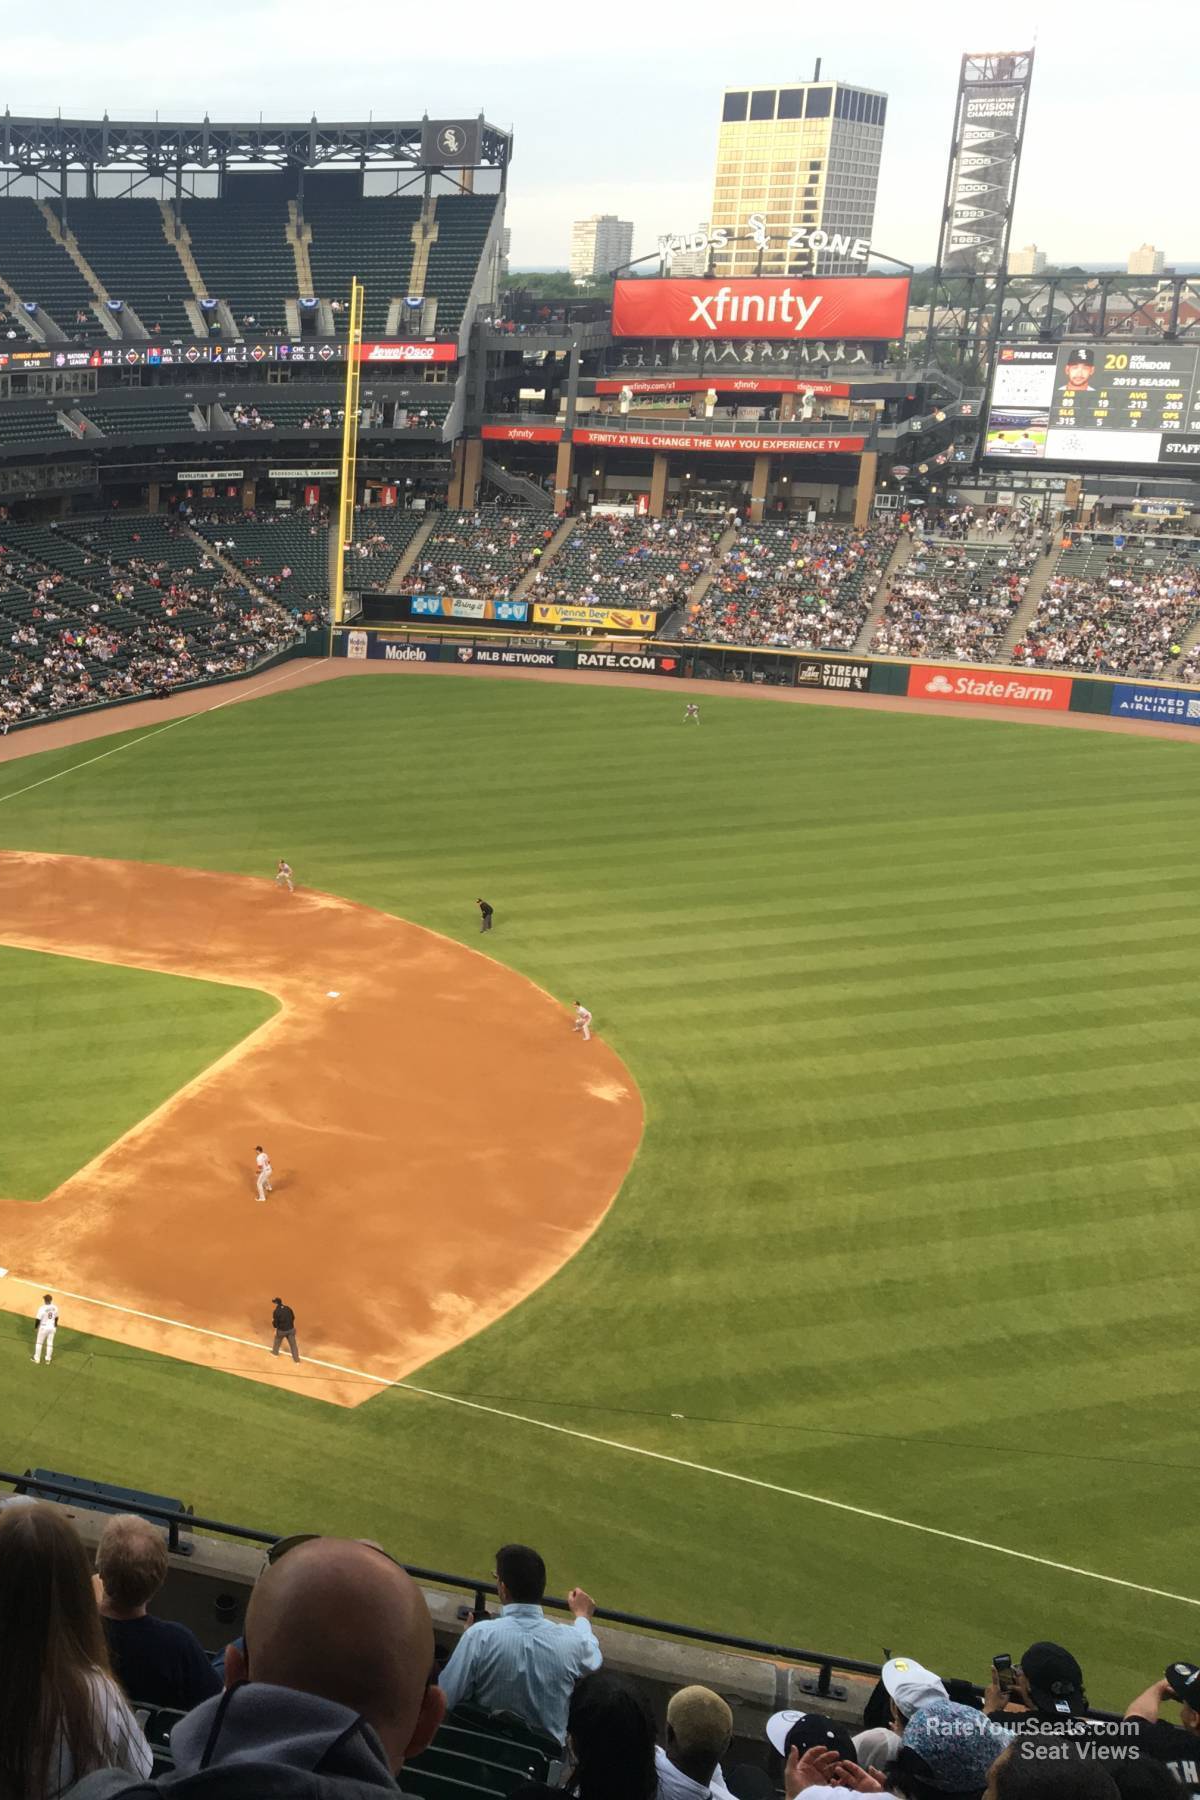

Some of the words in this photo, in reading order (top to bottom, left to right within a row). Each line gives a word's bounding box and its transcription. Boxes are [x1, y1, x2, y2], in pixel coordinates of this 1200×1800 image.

[968, 102, 1015, 111] DIVISION
[967, 110, 1014, 118] CHAMPIONS
[658, 227, 728, 261] KIDS
[788, 226, 872, 261] ZONE
[689, 286, 823, 331] xfinity
[1104, 354, 1128, 370] 20
[1129, 361, 1171, 370] RONDON
[734, 380, 760, 390] xfinity
[1113, 377, 1137, 386] 2019
[1139, 378, 1180, 387] SEASON
[508, 429, 534, 439] xfinity
[588, 433, 616, 443] XFINITY
[618, 435, 628, 444] X1
[630, 436, 651, 445] WILL
[652, 437, 691, 447] CHANGE
[693, 438, 712, 448] THE
[714, 439, 737, 449] WAY
[739, 439, 760, 449] YOU
[762, 440, 825, 449] EXPERIENCE
[826, 441, 840, 449] TV
[454, 599, 476, 610] Bring
[554, 607, 586, 617] Vienna
[589, 608, 610, 618] Beef
[385, 645, 427, 661] Modelo
[477, 651, 500, 661] MLB
[502, 652, 554, 664] NETWORK
[577, 654, 656, 670] RATE.COM
[823, 664, 869, 678] STREAM
[822, 675, 851, 688] YOUR
[1134, 695, 1185, 707] UNITED
[1120, 701, 1184, 715] AIRLINES
